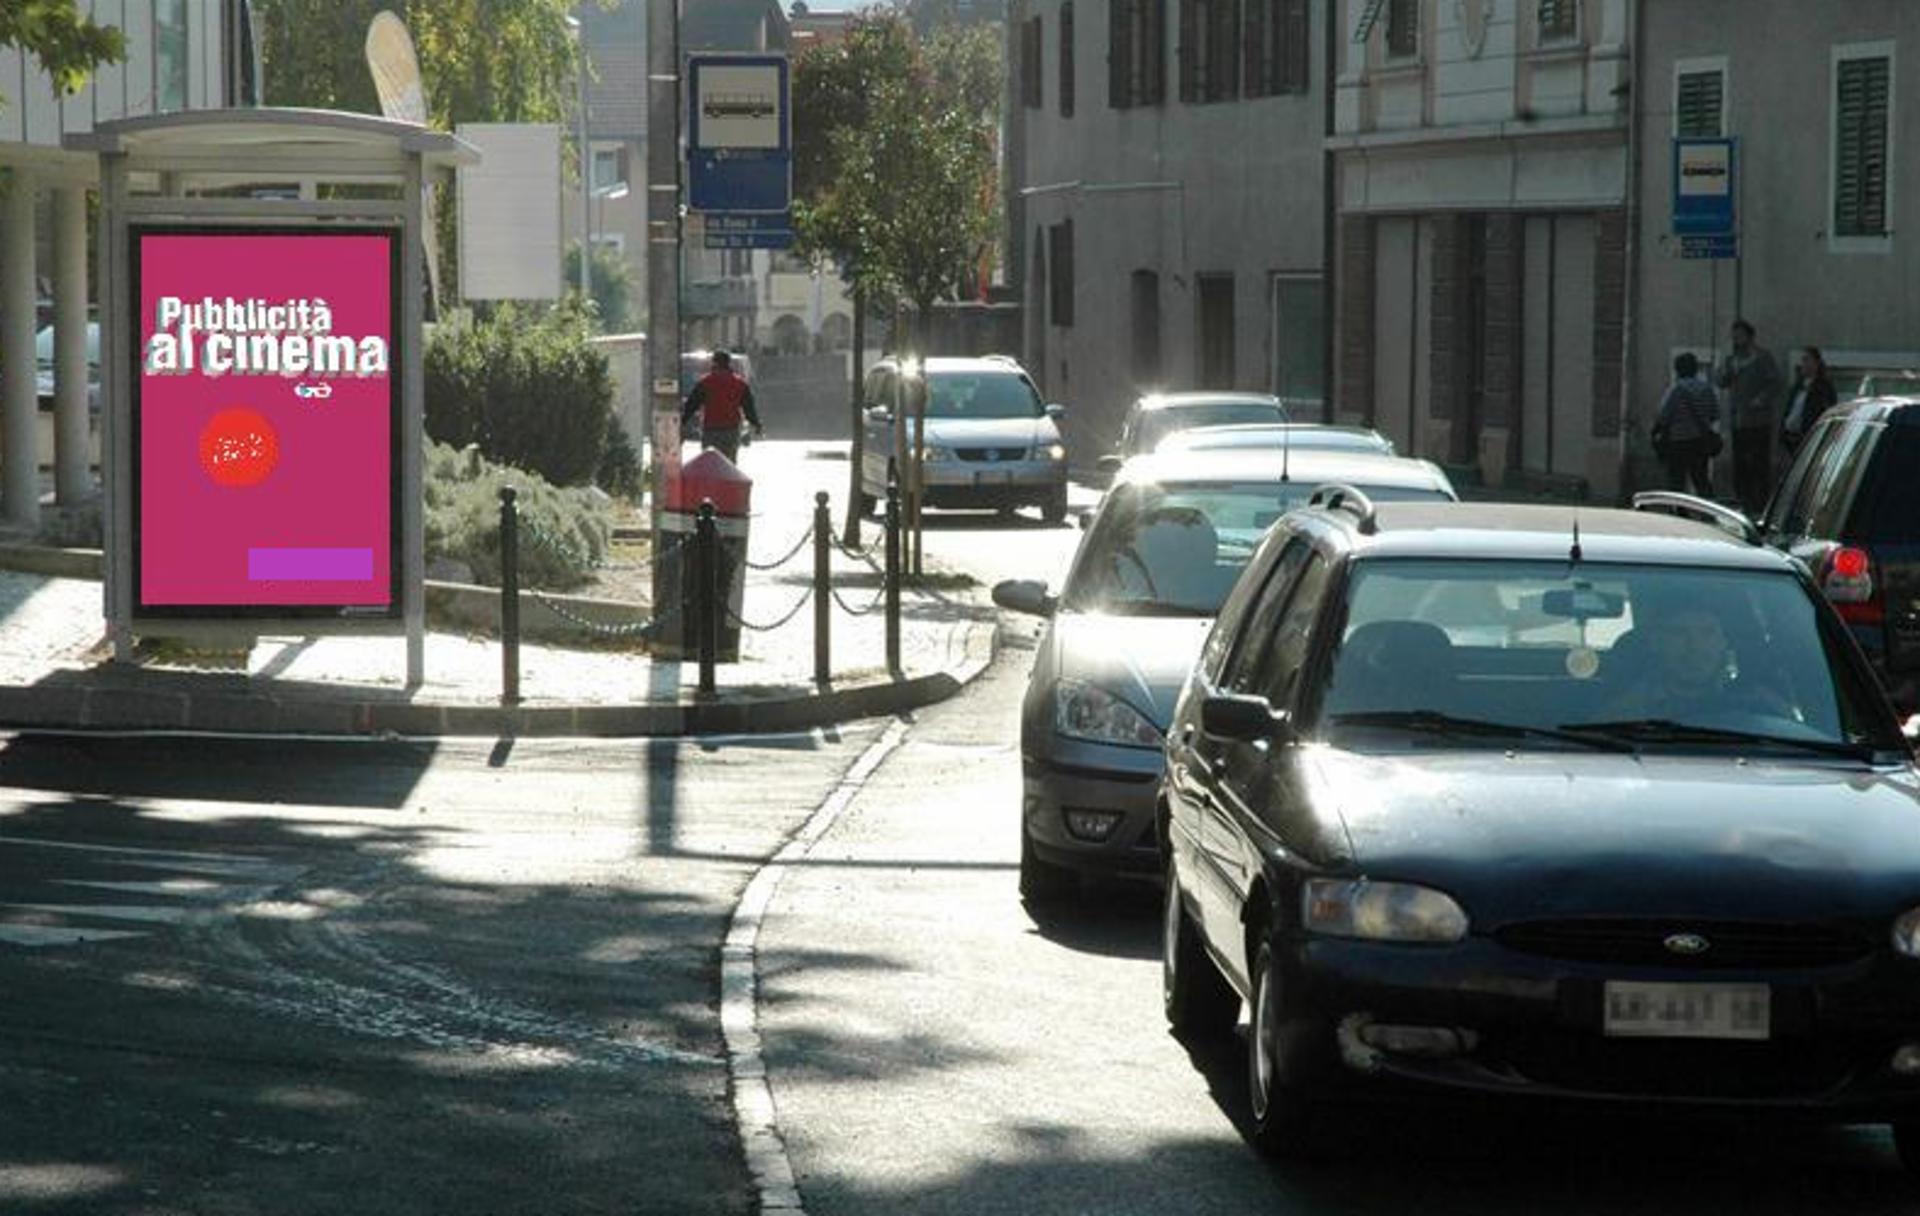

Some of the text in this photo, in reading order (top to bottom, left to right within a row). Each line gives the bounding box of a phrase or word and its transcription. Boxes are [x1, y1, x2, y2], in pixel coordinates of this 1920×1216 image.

[158, 297, 333, 332] Pubblicità
[146, 323, 387, 376] al cinema
